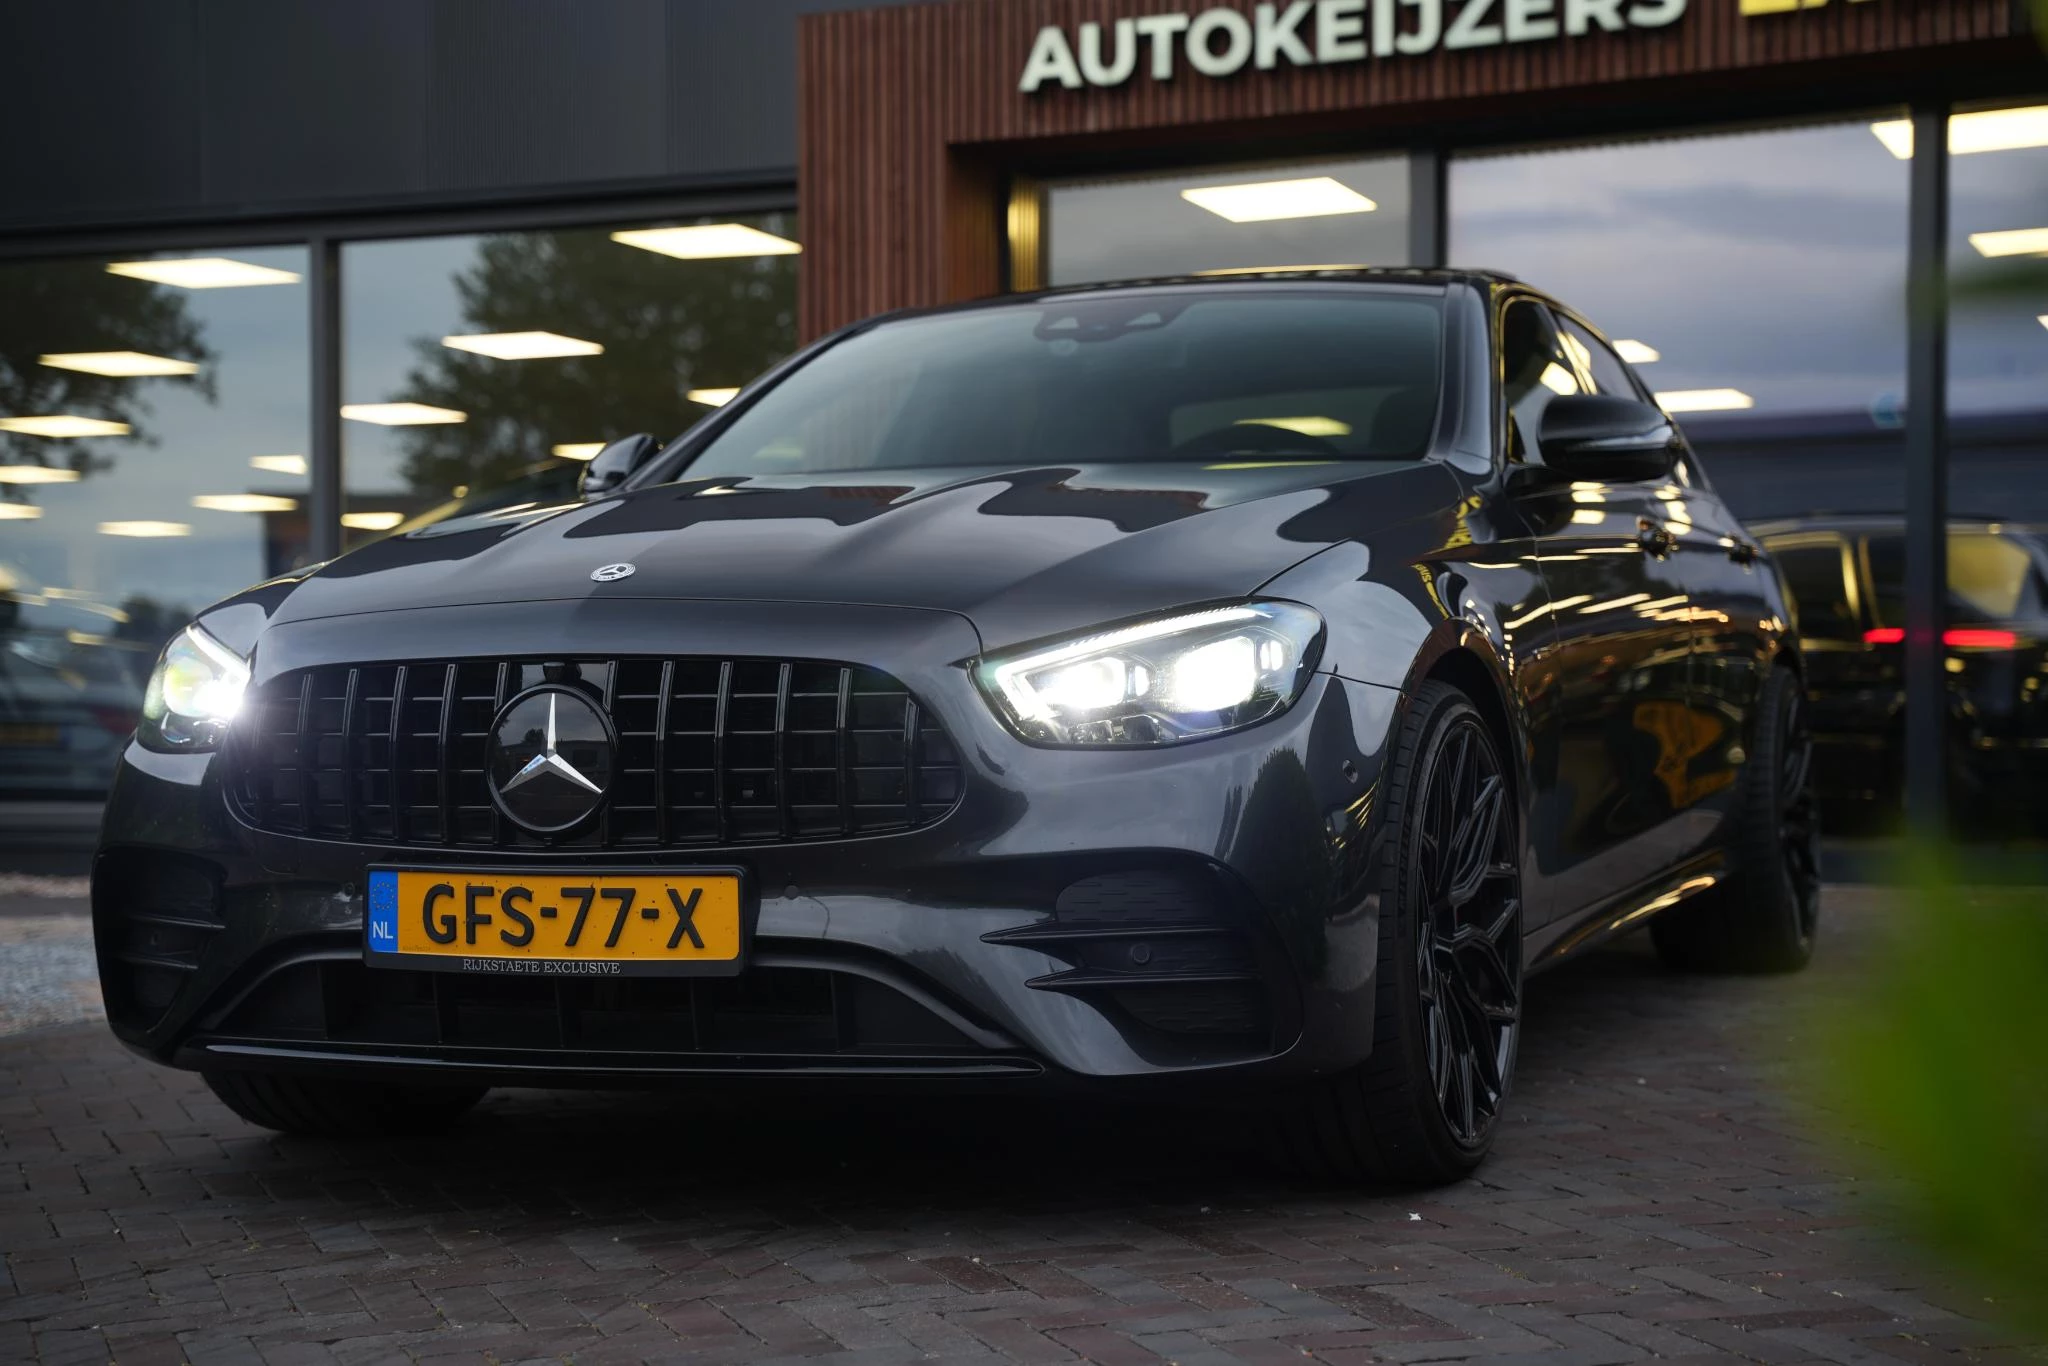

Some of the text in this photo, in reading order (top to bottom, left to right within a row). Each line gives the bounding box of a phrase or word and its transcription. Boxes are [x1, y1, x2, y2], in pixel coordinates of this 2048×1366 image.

[422, 883, 705, 949] GFS-77-X
[372, 921, 394, 939] NL
[463, 958, 621, 974] RIJKSTAETE EXCLUSIVE
